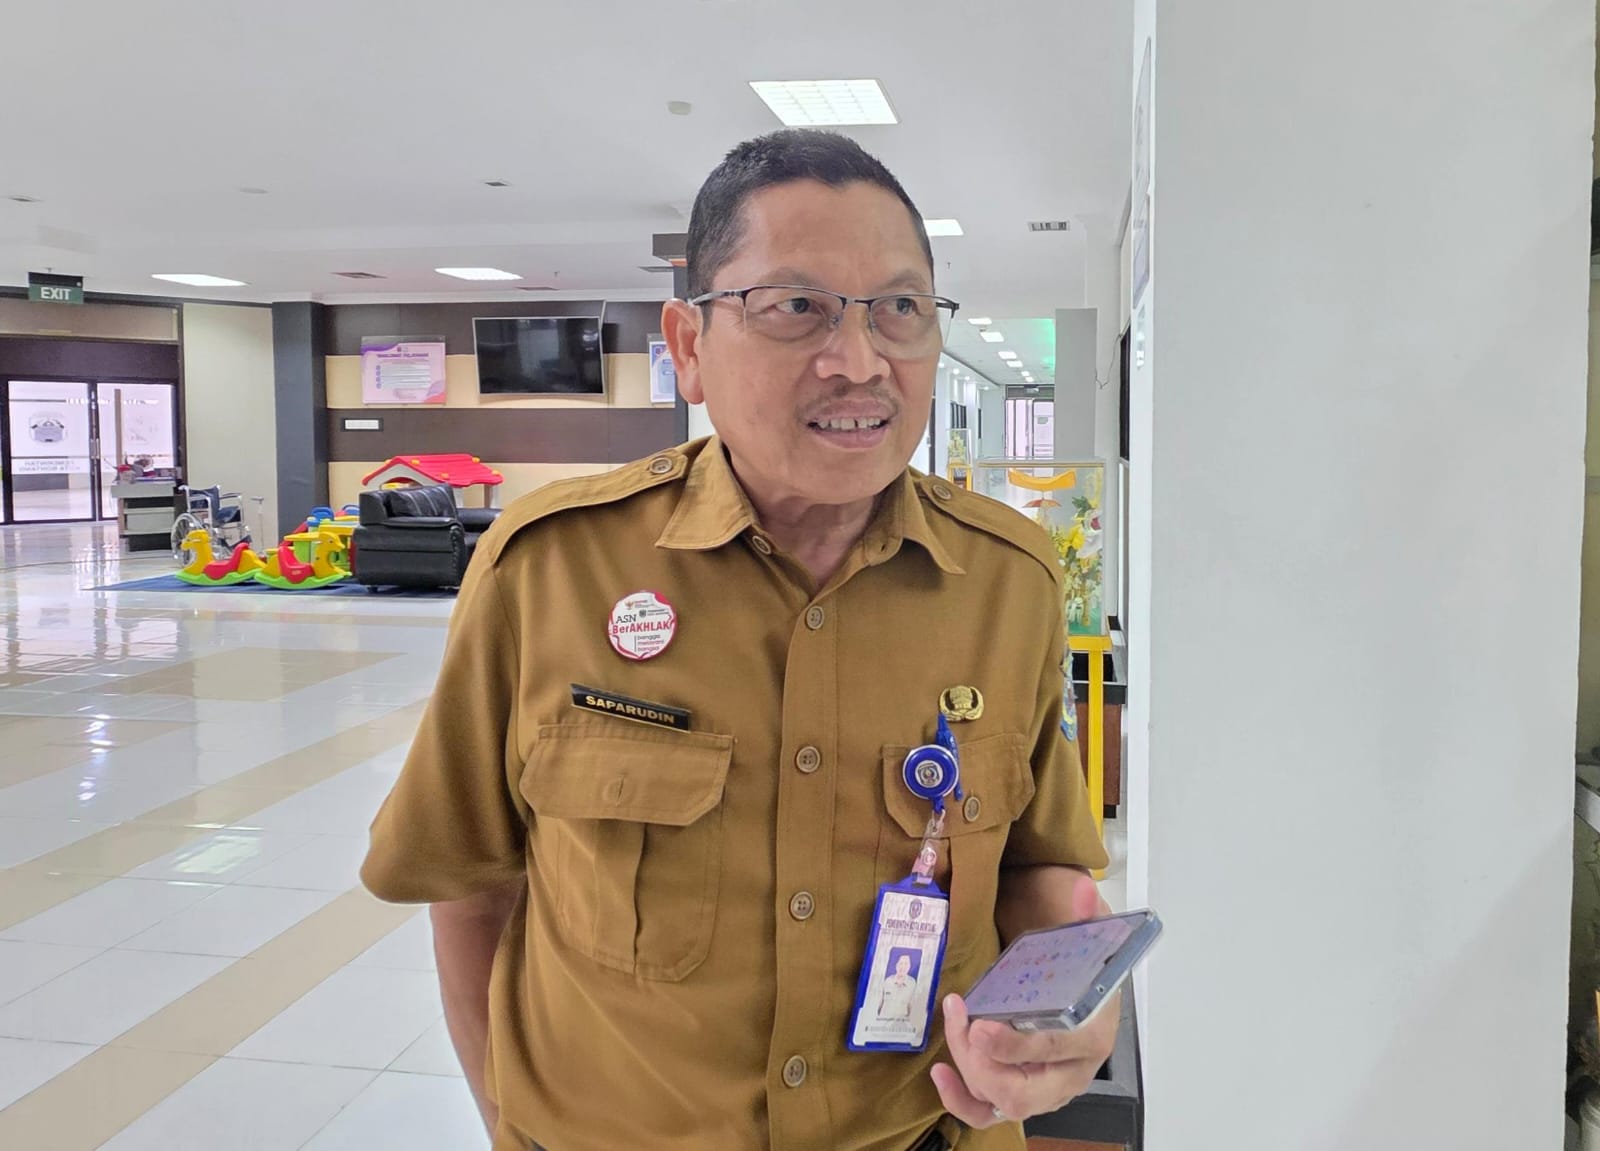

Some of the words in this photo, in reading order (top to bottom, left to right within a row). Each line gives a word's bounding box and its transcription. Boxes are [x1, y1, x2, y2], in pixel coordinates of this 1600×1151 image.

[41, 287, 71, 300] EXIT
[616, 614, 636, 624] ASN
[613, 620, 670, 634] BerAKHLAK
[585, 695, 675, 723] SAPARUDIN
